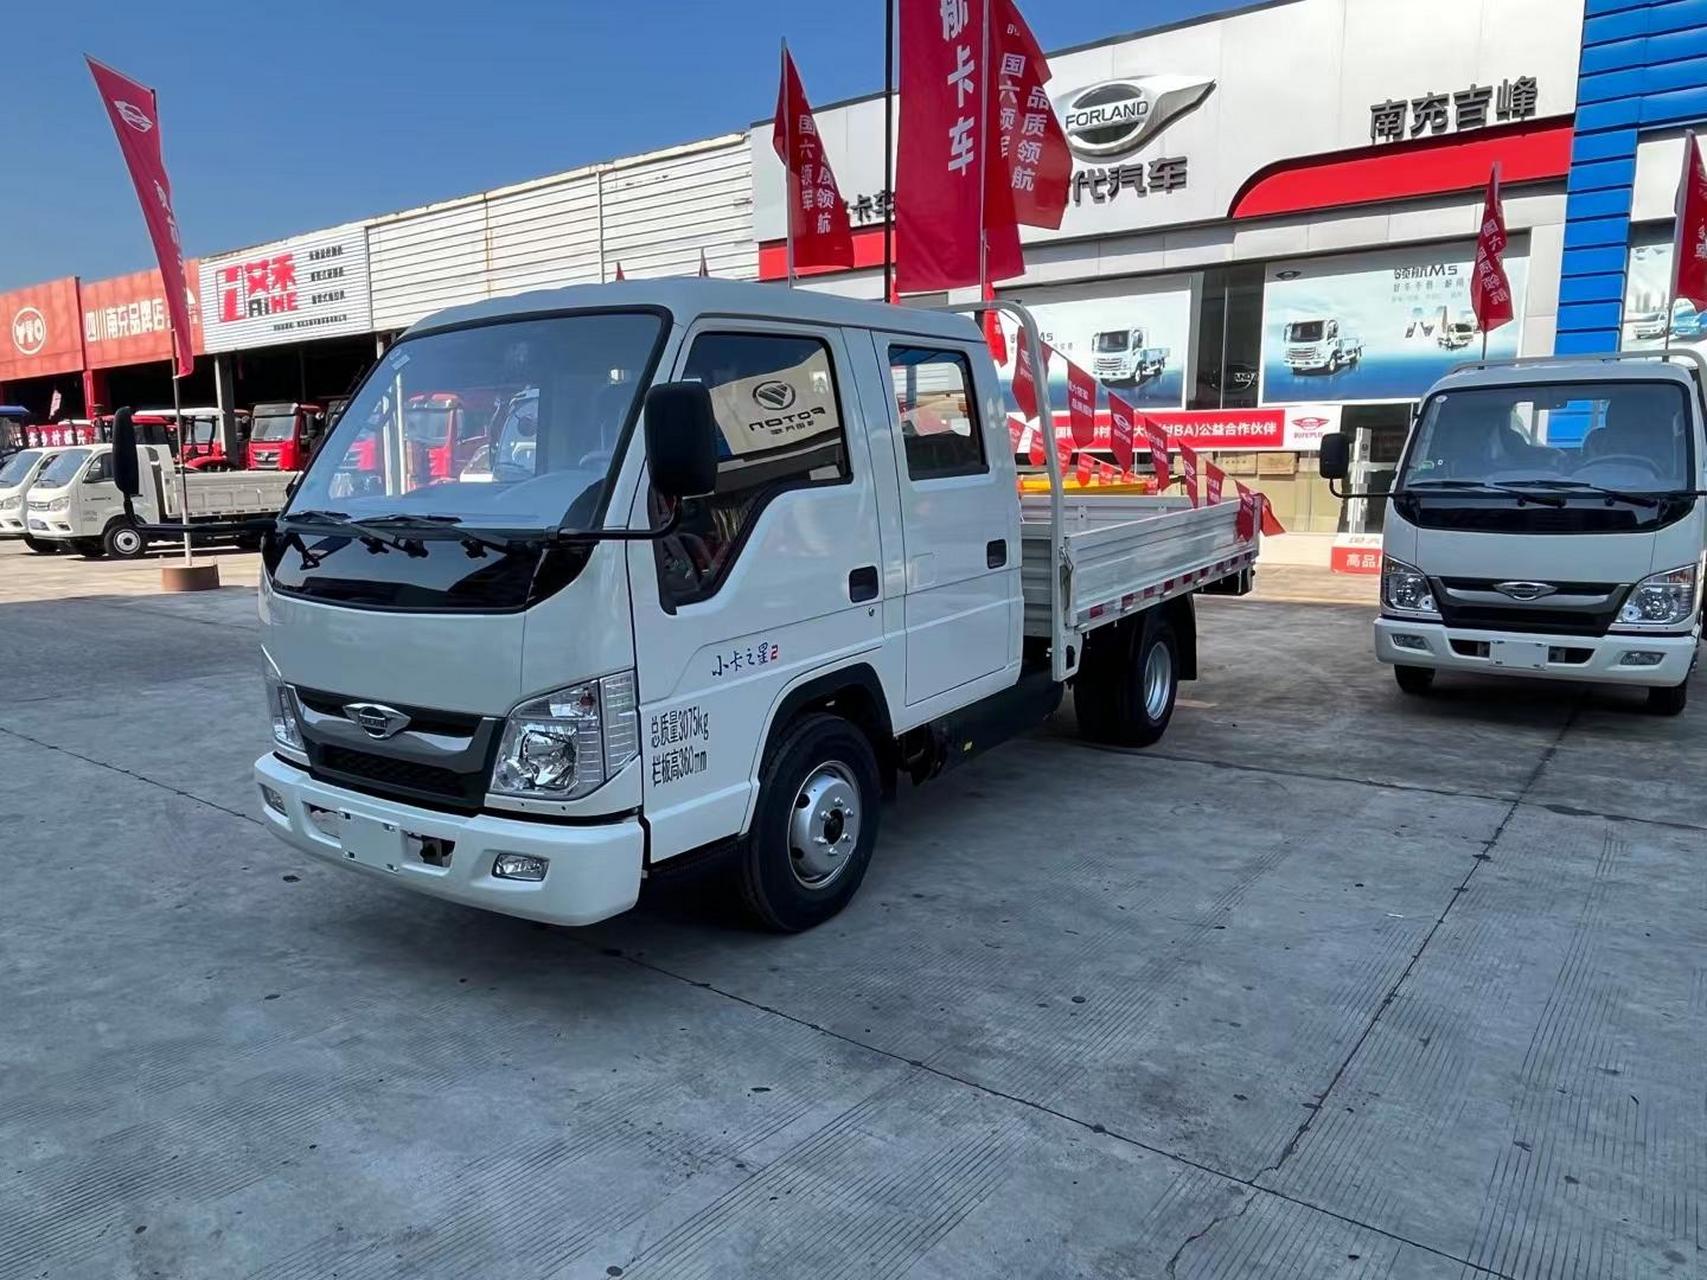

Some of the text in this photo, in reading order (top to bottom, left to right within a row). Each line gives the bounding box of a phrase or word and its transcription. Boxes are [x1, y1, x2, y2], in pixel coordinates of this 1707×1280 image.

[1065, 100, 1149, 129] FORLAND
[1370, 75, 1537, 145] 南充吉峰
[1011, 86, 1050, 192] 品质领航
[817, 154, 836, 234] 质领航
[844, 189, 896, 223] 卡车
[1346, 552, 1382, 568] 高品
[711, 641, 779, 677] 小卡之星2
[651, 705, 710, 749] 总质量3075kg
